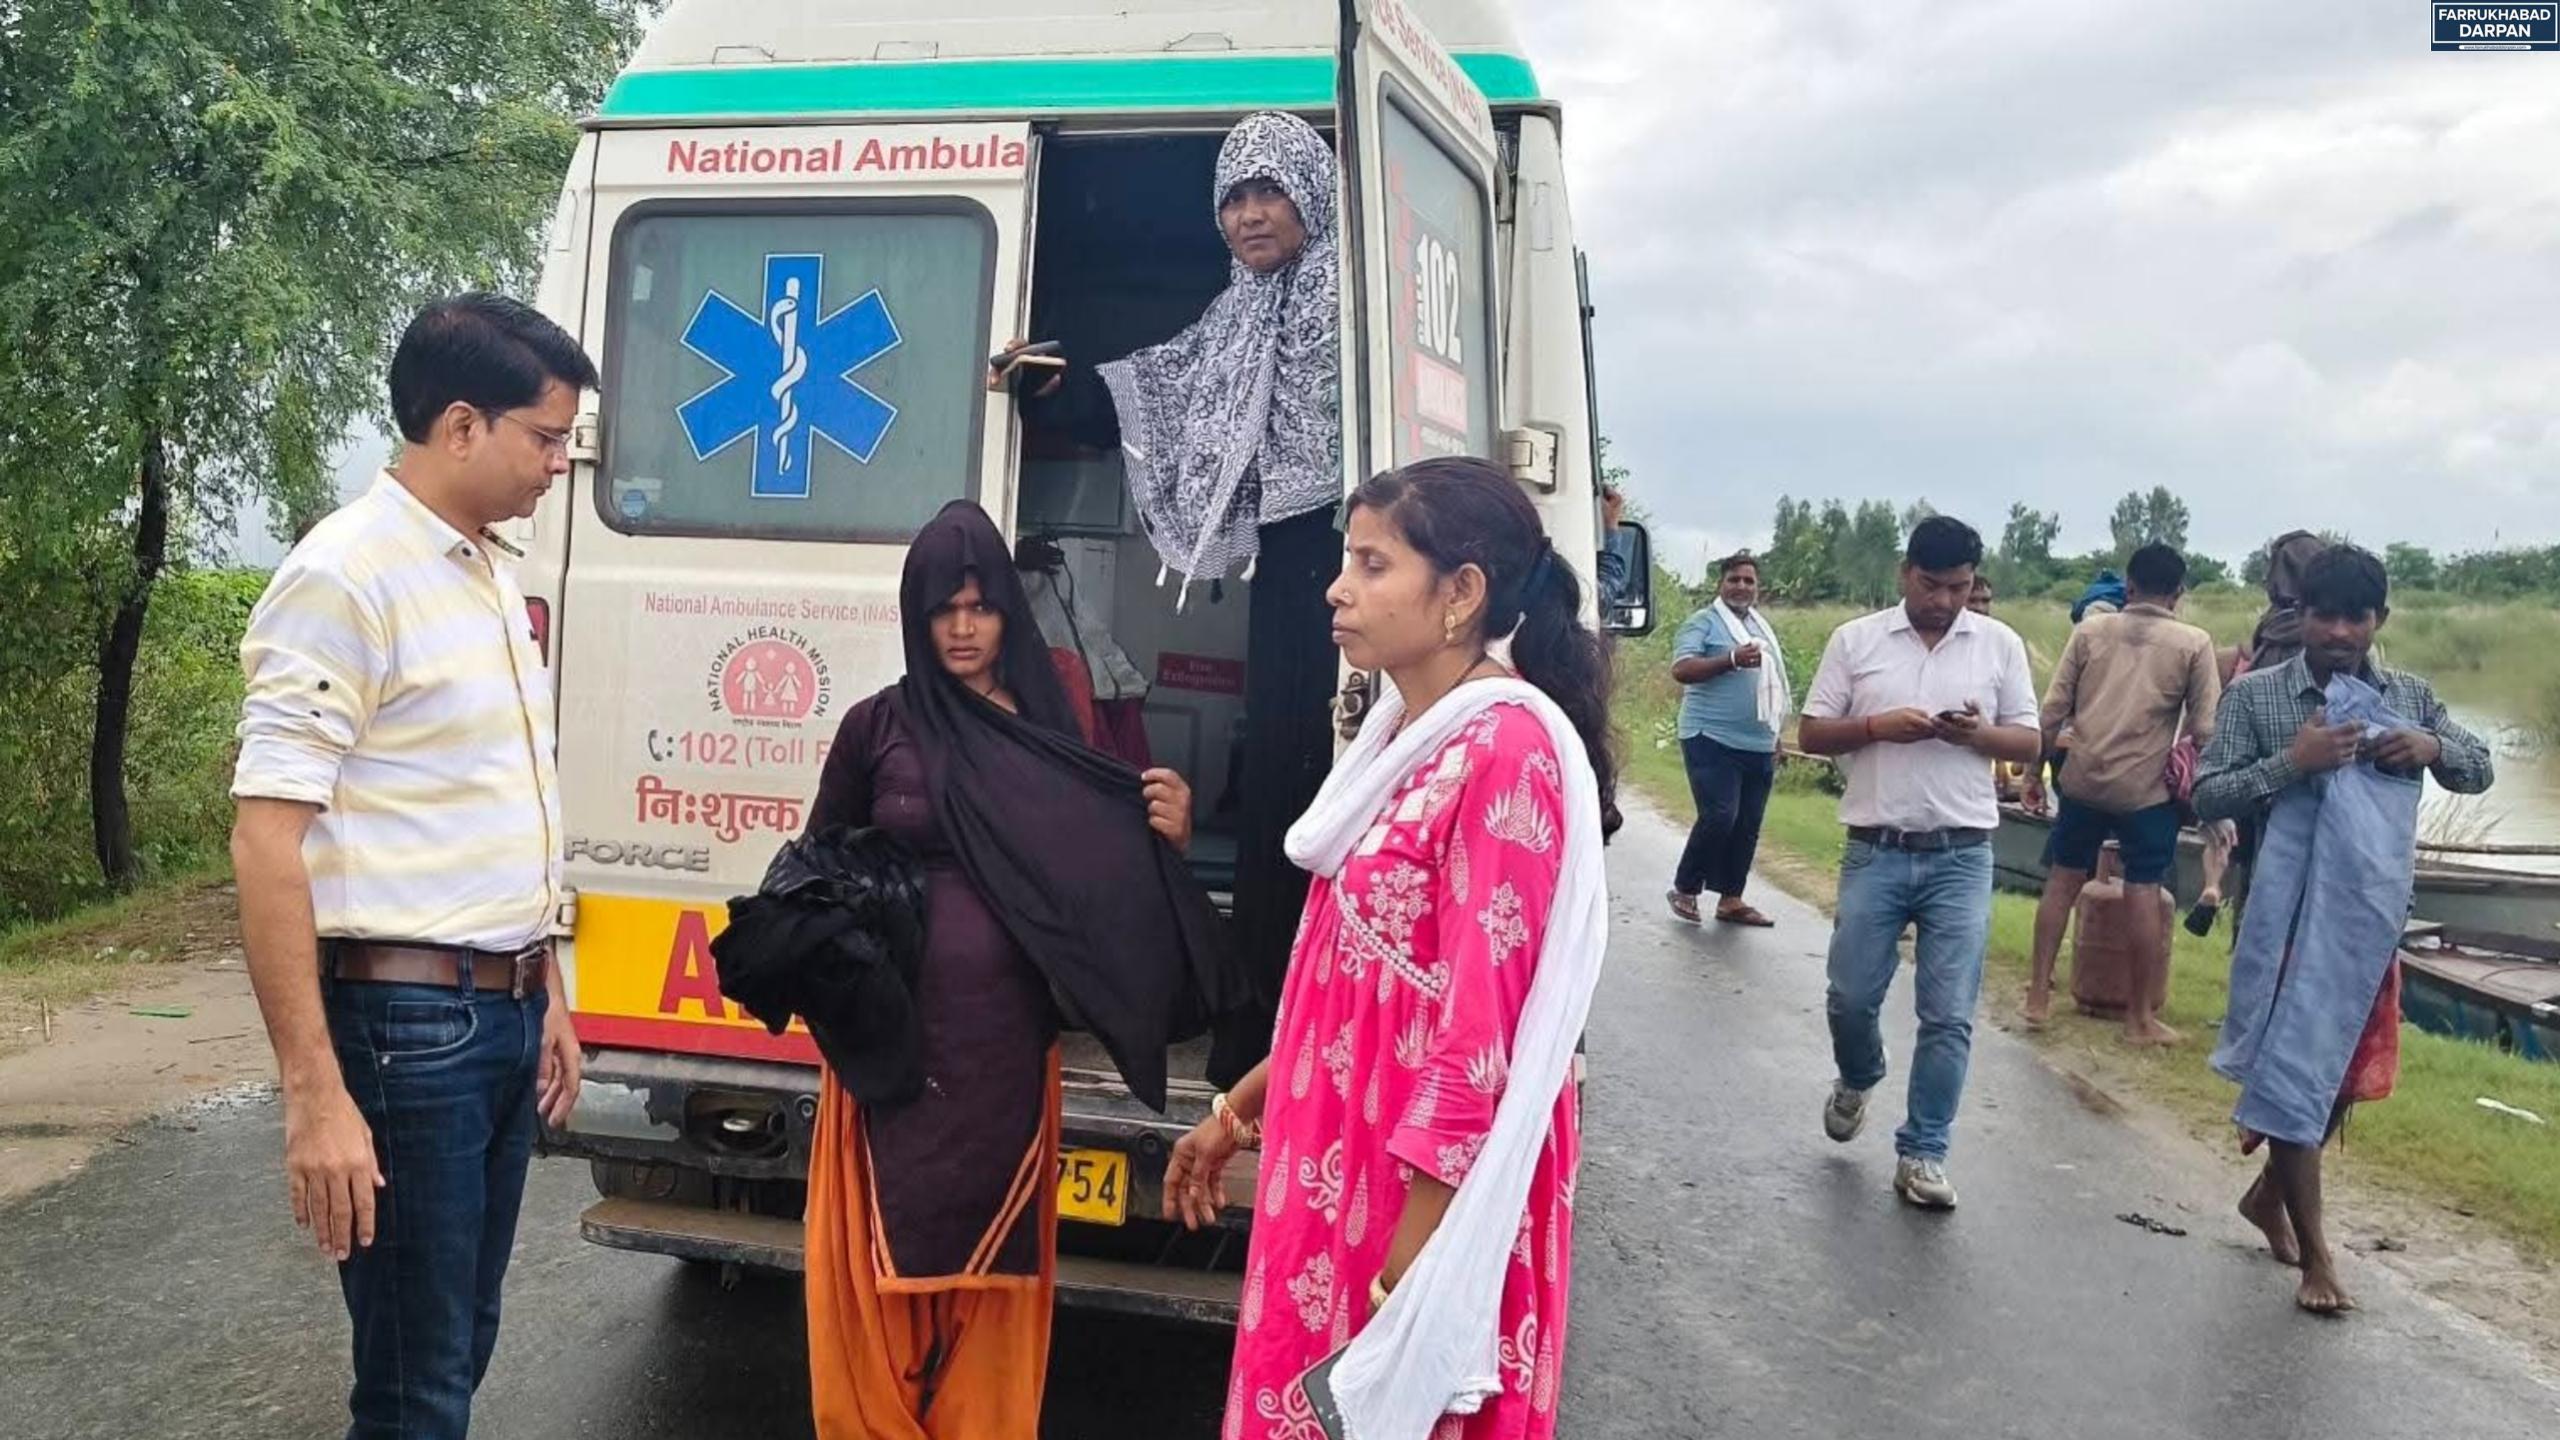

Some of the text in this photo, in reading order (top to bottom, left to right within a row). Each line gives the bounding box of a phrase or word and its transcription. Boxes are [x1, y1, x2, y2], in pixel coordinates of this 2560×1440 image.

[667, 134, 1026, 173] National Ambula
[1416, 232, 1463, 365] 102
[644, 591, 706, 615] National
[710, 594, 796, 618] Ambulance
[800, 598, 859, 621] Service
[706, 625, 831, 718] NATIONAL HEALTH MISSION
[635, 774, 804, 844] निःशुल्क
[563, 838, 710, 873] FORCE
